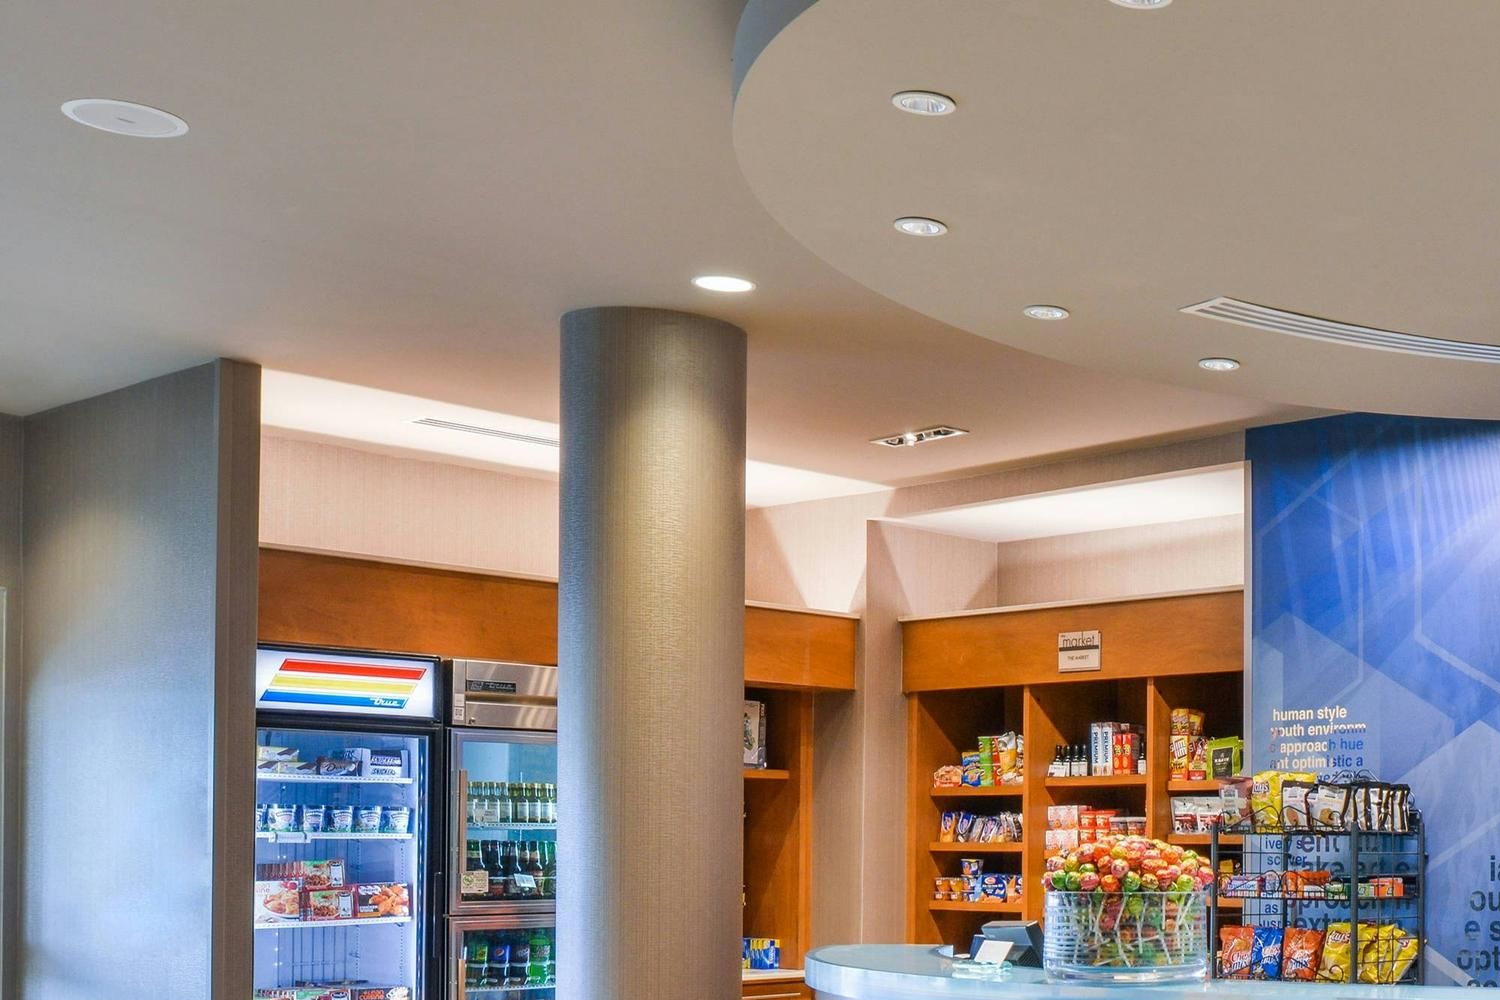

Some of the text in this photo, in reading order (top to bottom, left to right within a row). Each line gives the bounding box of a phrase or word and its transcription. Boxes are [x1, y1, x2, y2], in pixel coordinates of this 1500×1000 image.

[369, 696, 400, 706] True
[1272, 705, 1347, 722] human style
[1270, 723, 1305, 740] youth
[1280, 738, 1337, 756] approach
[1340, 738, 1364, 751] hue
[1291, 754, 1353, 771] optimistic
